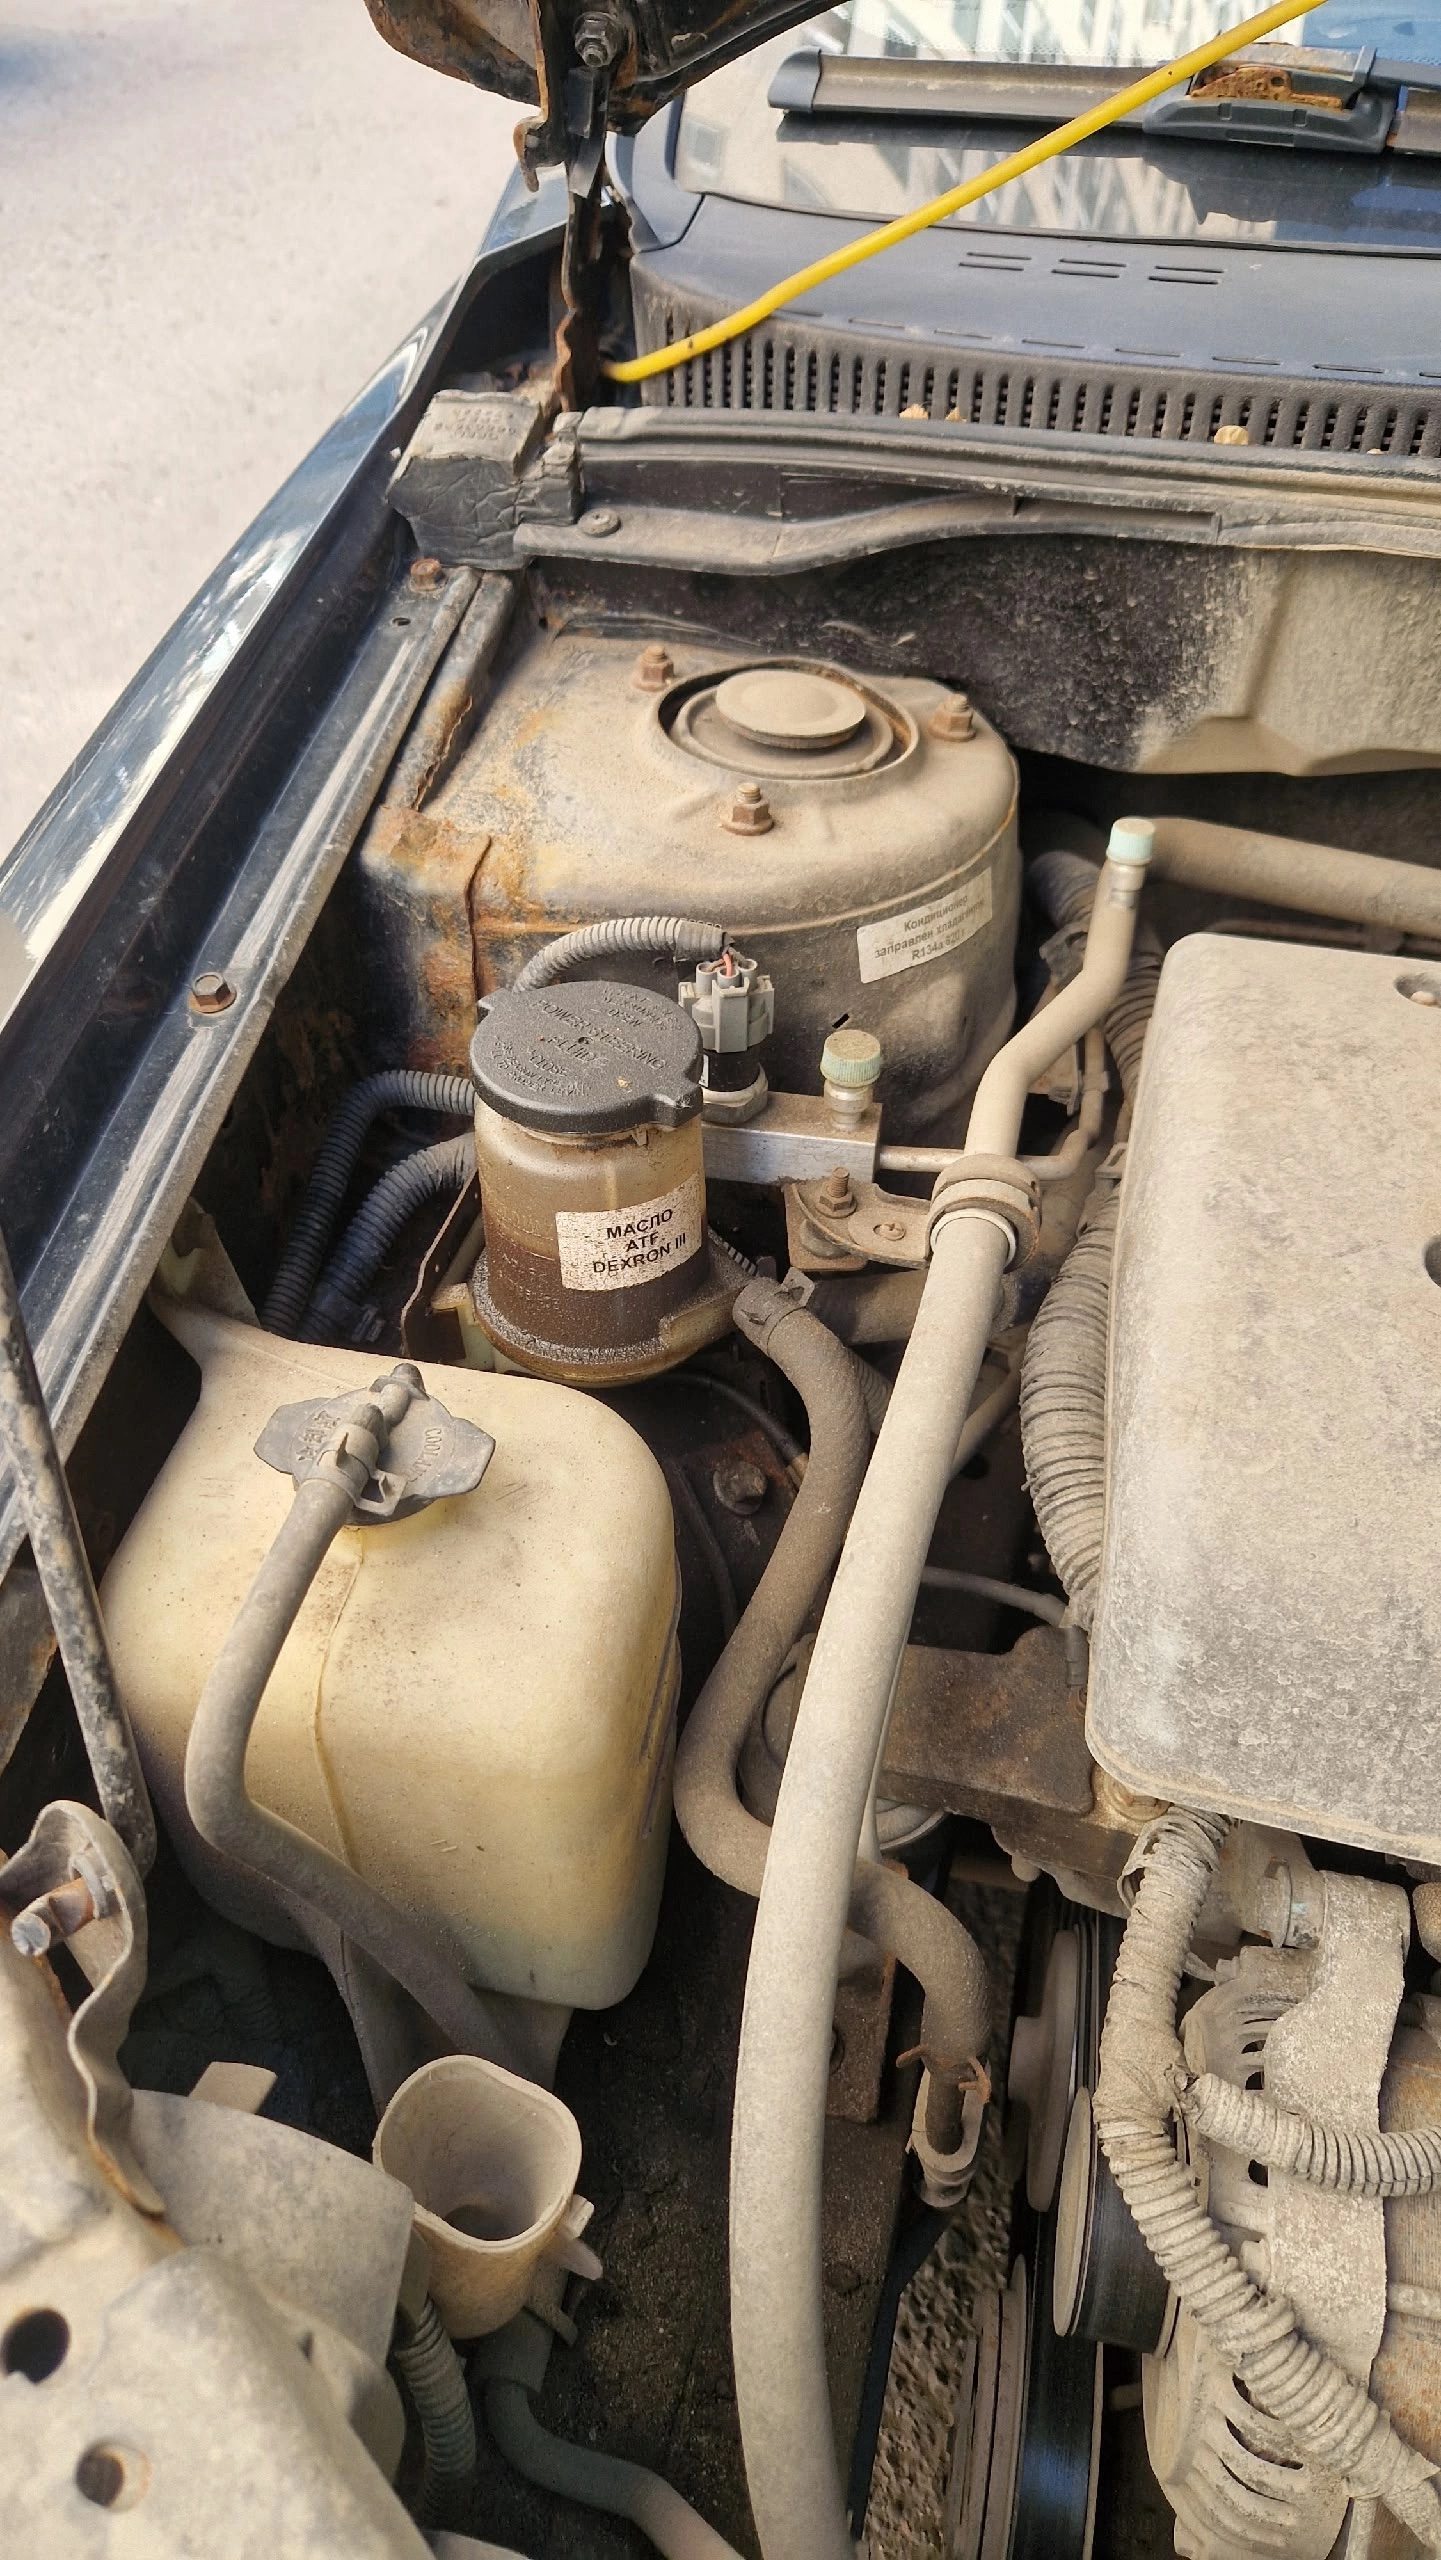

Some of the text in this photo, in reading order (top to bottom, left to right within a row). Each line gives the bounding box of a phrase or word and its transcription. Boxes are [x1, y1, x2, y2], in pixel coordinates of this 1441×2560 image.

[904, 895, 968, 932] Кондиционер
[874, 930, 934, 959] заправлен
[911, 942, 944, 961] R134a
[531, 999, 592, 1031] POWER
[588, 1025, 667, 1070] STEERING
[546, 1036, 597, 1062] FLUID
[606, 1208, 673, 1239] МАСЛО
[592, 1233, 686, 1273] DEXRON III
[626, 1232, 659, 1252] ATF
